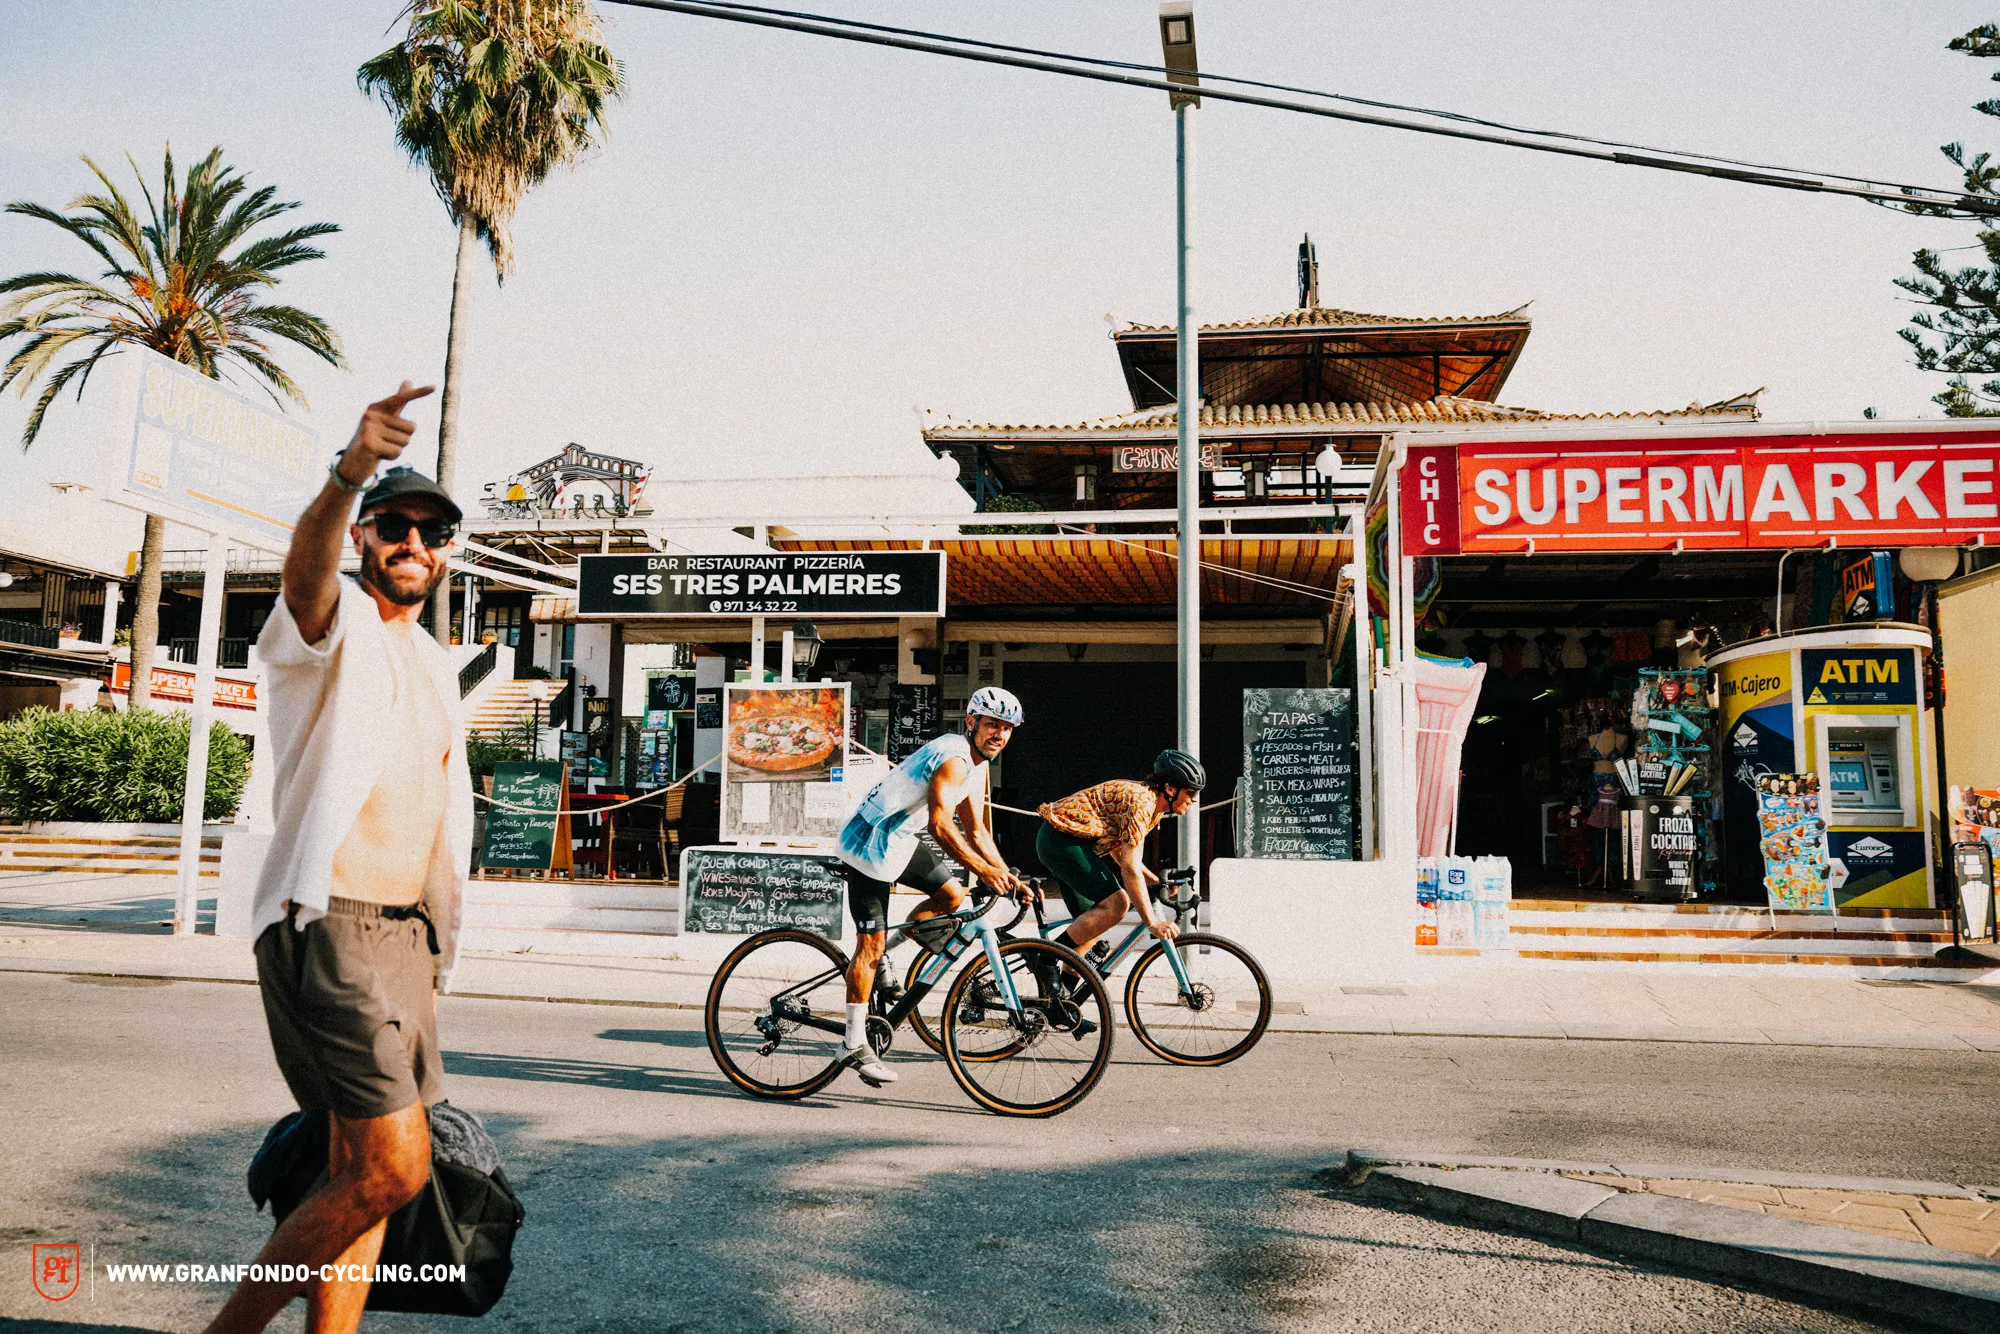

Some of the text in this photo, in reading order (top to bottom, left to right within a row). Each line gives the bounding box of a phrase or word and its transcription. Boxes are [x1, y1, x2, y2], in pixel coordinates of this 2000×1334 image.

[143, 363, 314, 480] SUPERMARKET
[1474, 459, 2000, 526] SUPERMARKE
[1419, 456, 1441, 545] CHIC
[647, 554, 865, 570] BAR RESTAURANT PIZZERÍA
[1846, 559, 1874, 594] ATM
[612, 573, 901, 596] SES TRES PALMERES
[723, 601, 798, 612] 971 34 32 22
[1819, 659, 1899, 684] ATM
[150, 671, 250, 698] UPERMRKET
[1267, 712, 1317, 726] TAPAS
[1263, 727, 1298, 740] PIZZAS
[1261, 741, 1334, 752] PESCADOS FISH
[1262, 754, 1334, 765] CARNES MEAT
[1263, 766, 1304, 778] BURGERS
[1829, 770, 1860, 783] ATM
[1264, 780, 1286, 791] TEX
[1287, 779, 1306, 790] MEX
[1313, 778, 1340, 789] WRAPS
[1265, 794, 1303, 805] SALADS
[1275, 806, 1311, 815] PASTA
[1265, 826, 1306, 834] OMELETTES
[1659, 817, 1693, 834] FROZEN
[1264, 837, 1301, 852] FROZEN
[1651, 833, 1697, 851] COCKTAILS
[1855, 843, 1885, 851] Euronet
[700, 871, 731, 883] WINES
[742, 899, 765, 910] AND
